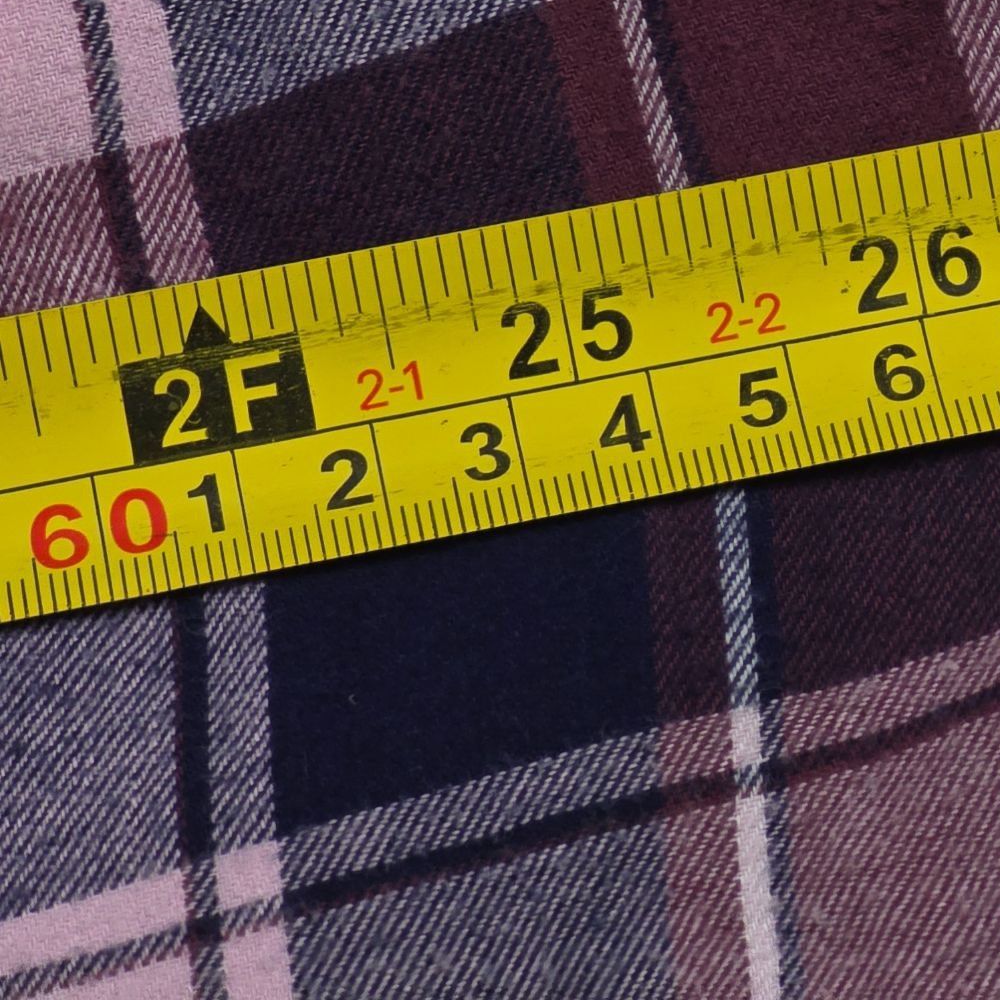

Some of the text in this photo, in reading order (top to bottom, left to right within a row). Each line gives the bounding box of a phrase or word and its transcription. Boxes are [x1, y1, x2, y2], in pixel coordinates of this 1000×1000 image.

[153, 350, 282, 449] 2F
[356, 360, 425, 411] 2-1
[500, 284, 633, 380] 25
[706, 292, 786, 344] 2-2
[849, 223, 983, 315] 26
[30, 488, 168, 569] 60
[187, 473, 226, 533] 1
[320, 449, 375, 510] 2
[459, 422, 511, 481] 3
[600, 394, 652, 453] 4
[738, 367, 789, 428] 5
[872, 344, 925, 401] 6
